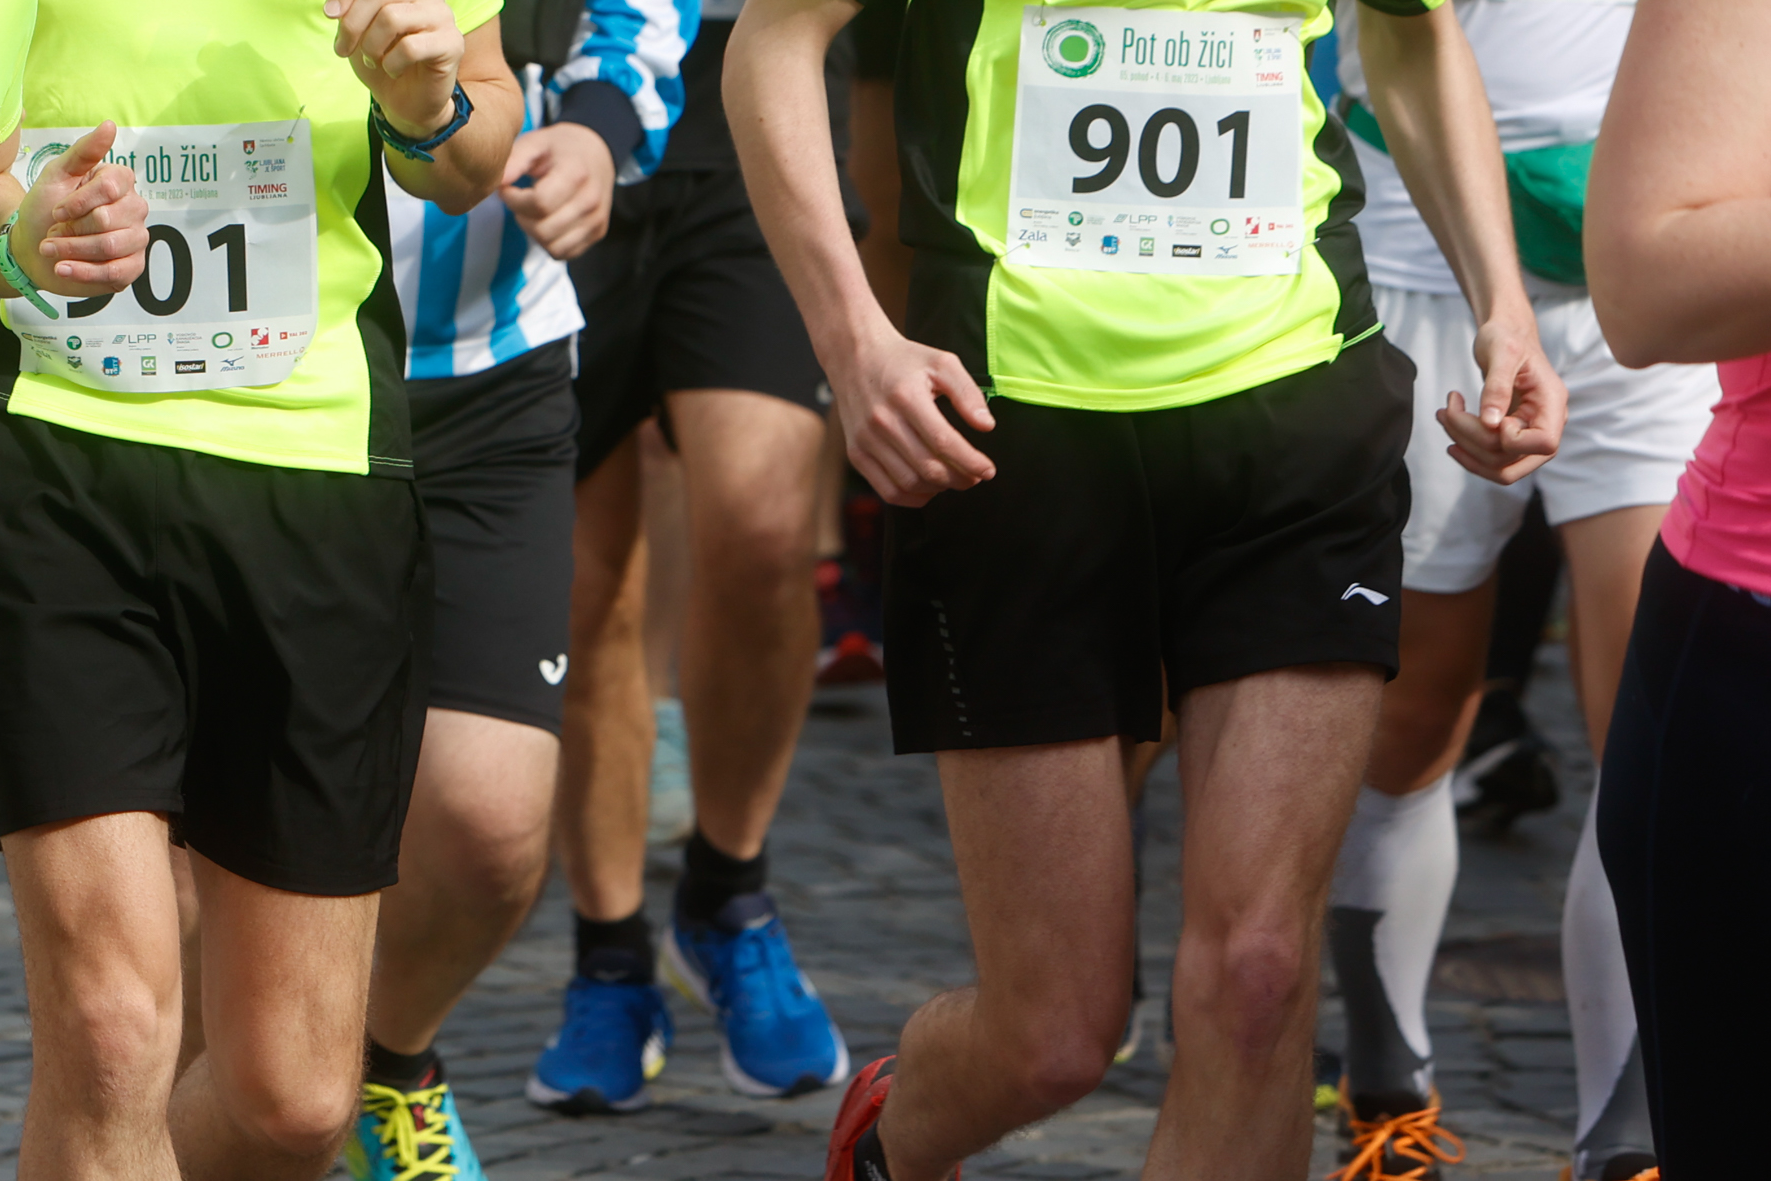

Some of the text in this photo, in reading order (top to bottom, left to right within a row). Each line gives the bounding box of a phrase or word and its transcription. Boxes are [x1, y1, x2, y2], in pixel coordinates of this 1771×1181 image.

[1121, 28, 1234, 68] Pot ob žici
[1256, 72, 1283, 82] TIMING
[1068, 104, 1250, 198] 901
[145, 145, 172, 184] ob
[181, 145, 218, 183] žici
[169, 189, 183, 199] 2023
[190, 188, 218, 200] Ljubljana
[248, 183, 287, 195] TIMING
[1129, 214, 1157, 224] LPP
[1019, 229, 1048, 242] Zala
[67, 223, 248, 319] 01
[128, 334, 156, 343] LPP
[256, 349, 298, 359] MERRELL
